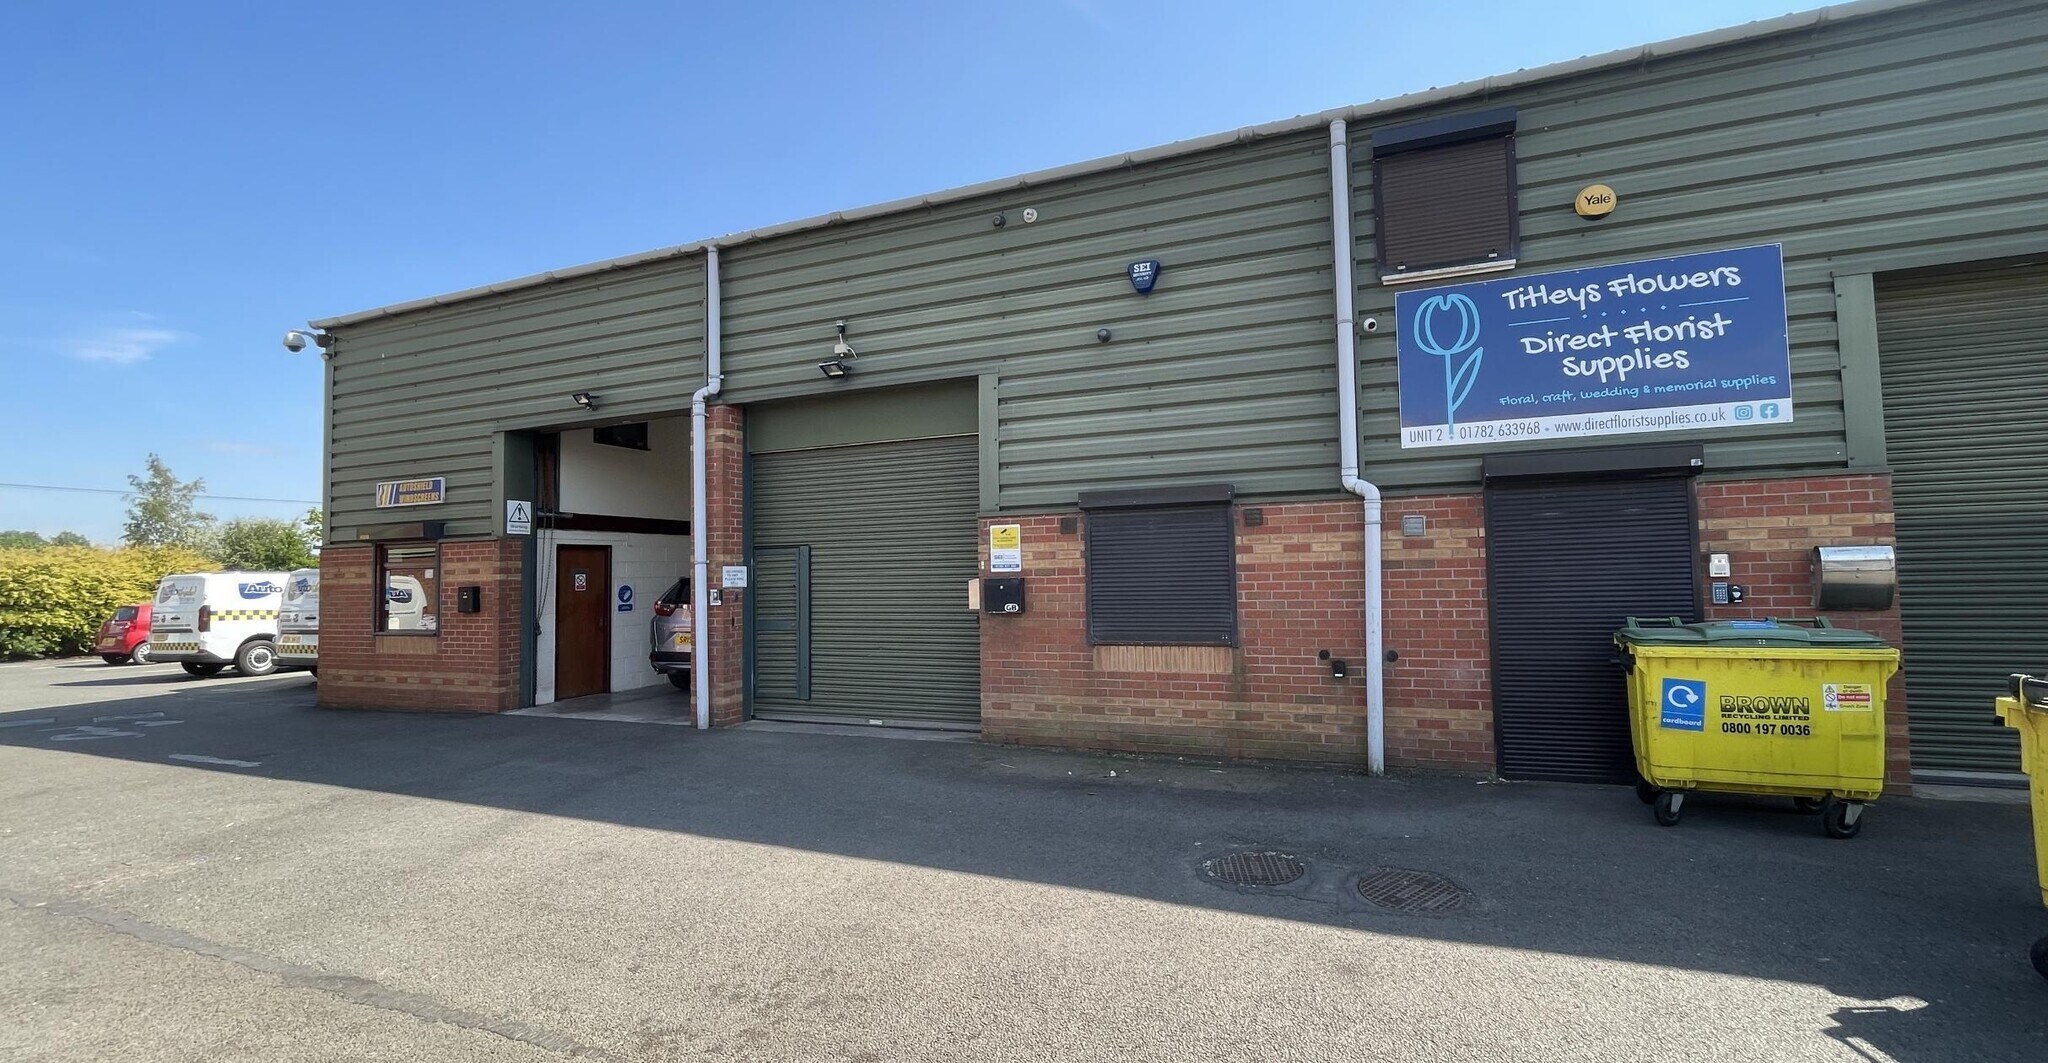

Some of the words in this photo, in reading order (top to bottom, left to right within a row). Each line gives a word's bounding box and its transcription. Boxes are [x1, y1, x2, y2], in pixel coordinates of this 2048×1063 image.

[1584, 194, 1611, 205] Yale
[1133, 263, 1151, 273] SEI
[1607, 266, 1742, 297] Flowers
[1520, 325, 1619, 354] Direct
[1623, 313, 1733, 344] Florist
[1562, 347, 1690, 383] Supplies
[1499, 394, 1539, 406] Floral,
[1542, 389, 1576, 403] craft,
[1580, 385, 1639, 400] wedding
[1643, 385, 1651, 394] &
[1654, 378, 1717, 394] memorial
[1721, 374, 1777, 390] supplies
[1410, 429, 1433, 443] UNIT
[1436, 428, 1443, 442] 2
[1459, 424, 1494, 440] 01782
[1498, 421, 1541, 437] 633968
[1554, 407, 1726, 433] www.directfloristsupplies.co.uk
[399, 480, 433, 491] AUTOSHIELD
[244, 584, 283, 594] Auto
[1720, 696, 1810, 714] BROWN
[1662, 717, 1702, 726] cardboard
[1722, 722, 1751, 733] 0800
[1755, 723, 1776, 734] 197
[1780, 724, 1810, 735] 0036
